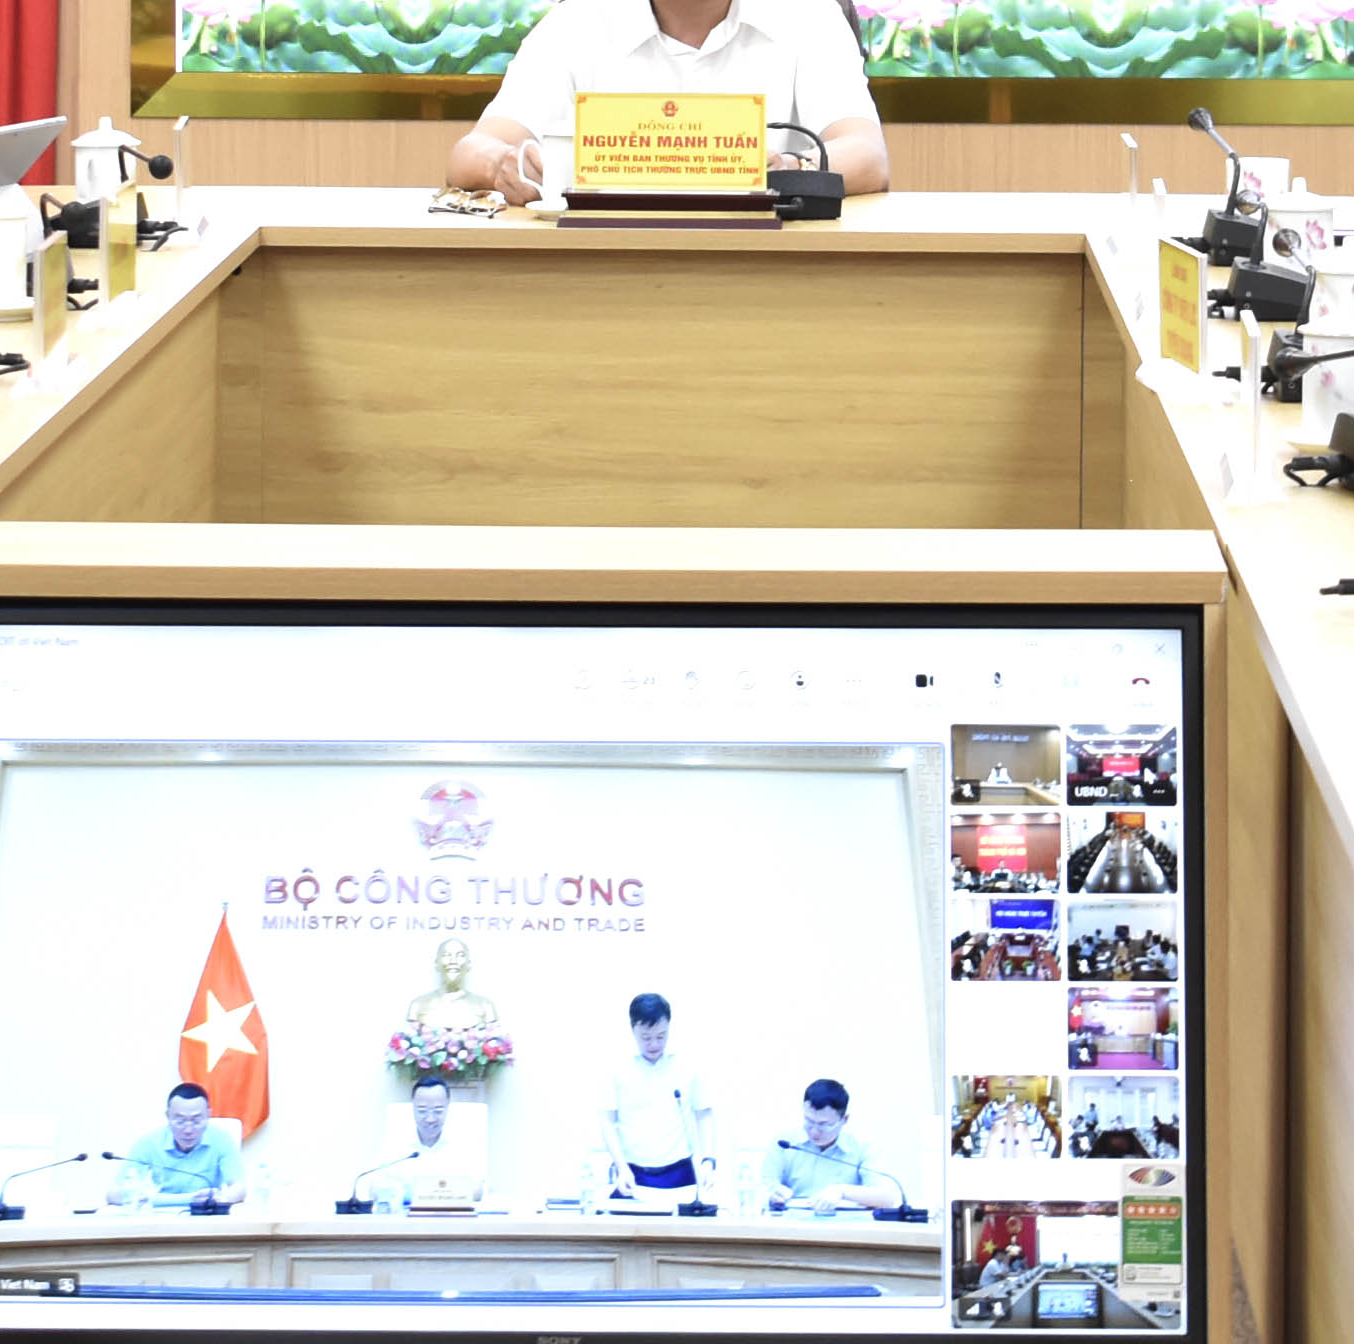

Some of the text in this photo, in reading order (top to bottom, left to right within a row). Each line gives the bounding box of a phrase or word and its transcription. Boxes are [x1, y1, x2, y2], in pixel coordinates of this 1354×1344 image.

[582, 130, 758, 151] NGUYỄN MẠNH TUẤN
[632, 154, 652, 163] BAN
[264, 867, 646, 912] BỘ CÔNG THƯƠNG
[261, 915, 646, 933] MINISTRY OF INDUSTRY AND TRADE
